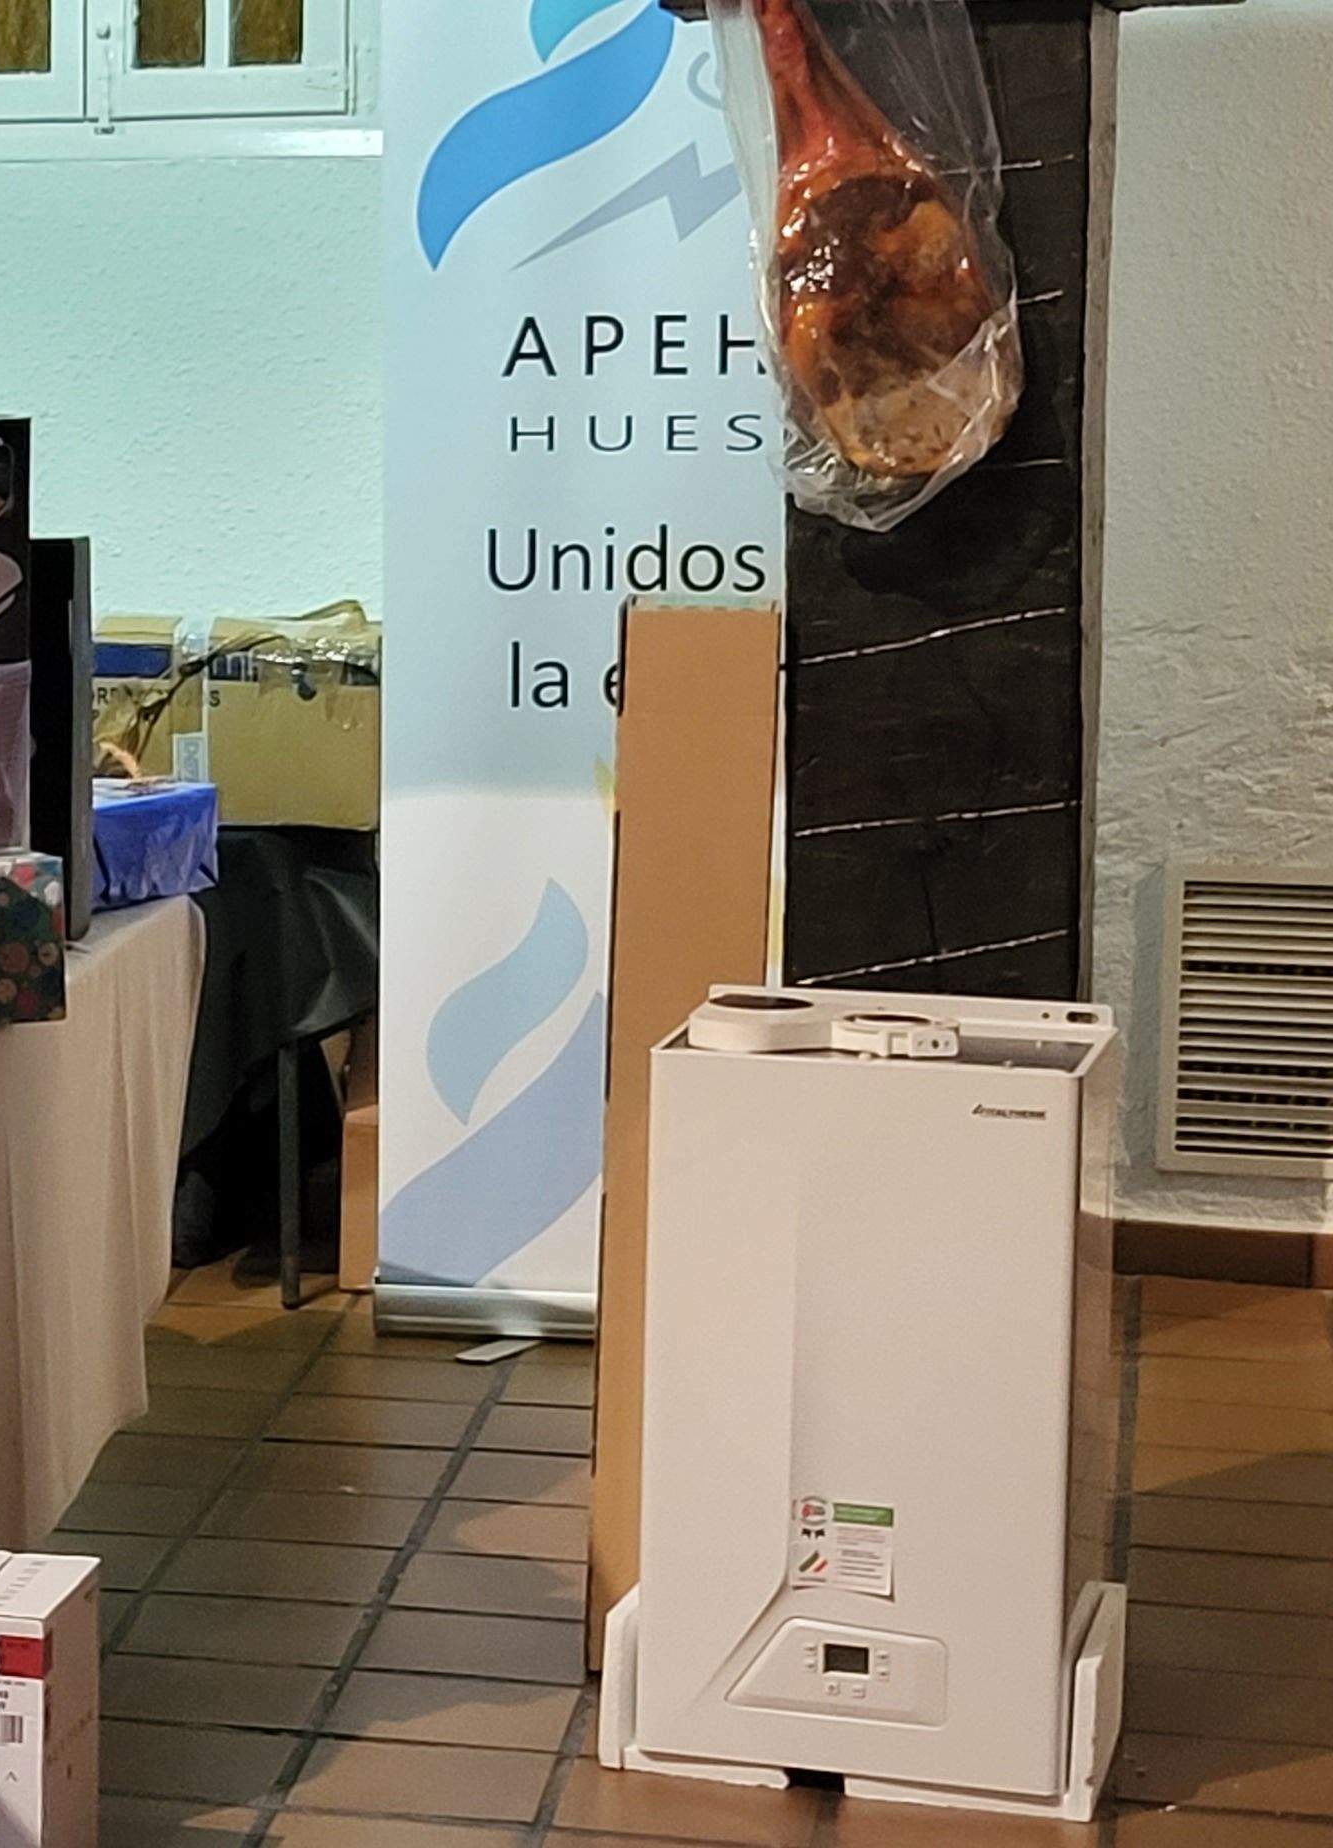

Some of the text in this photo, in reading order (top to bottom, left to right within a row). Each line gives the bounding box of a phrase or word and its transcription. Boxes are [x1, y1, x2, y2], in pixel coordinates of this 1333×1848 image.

[502, 314, 767, 377] APEH
[510, 414, 764, 452] HUES
[486, 523, 766, 593] Unidos
[511, 641, 569, 709] la
